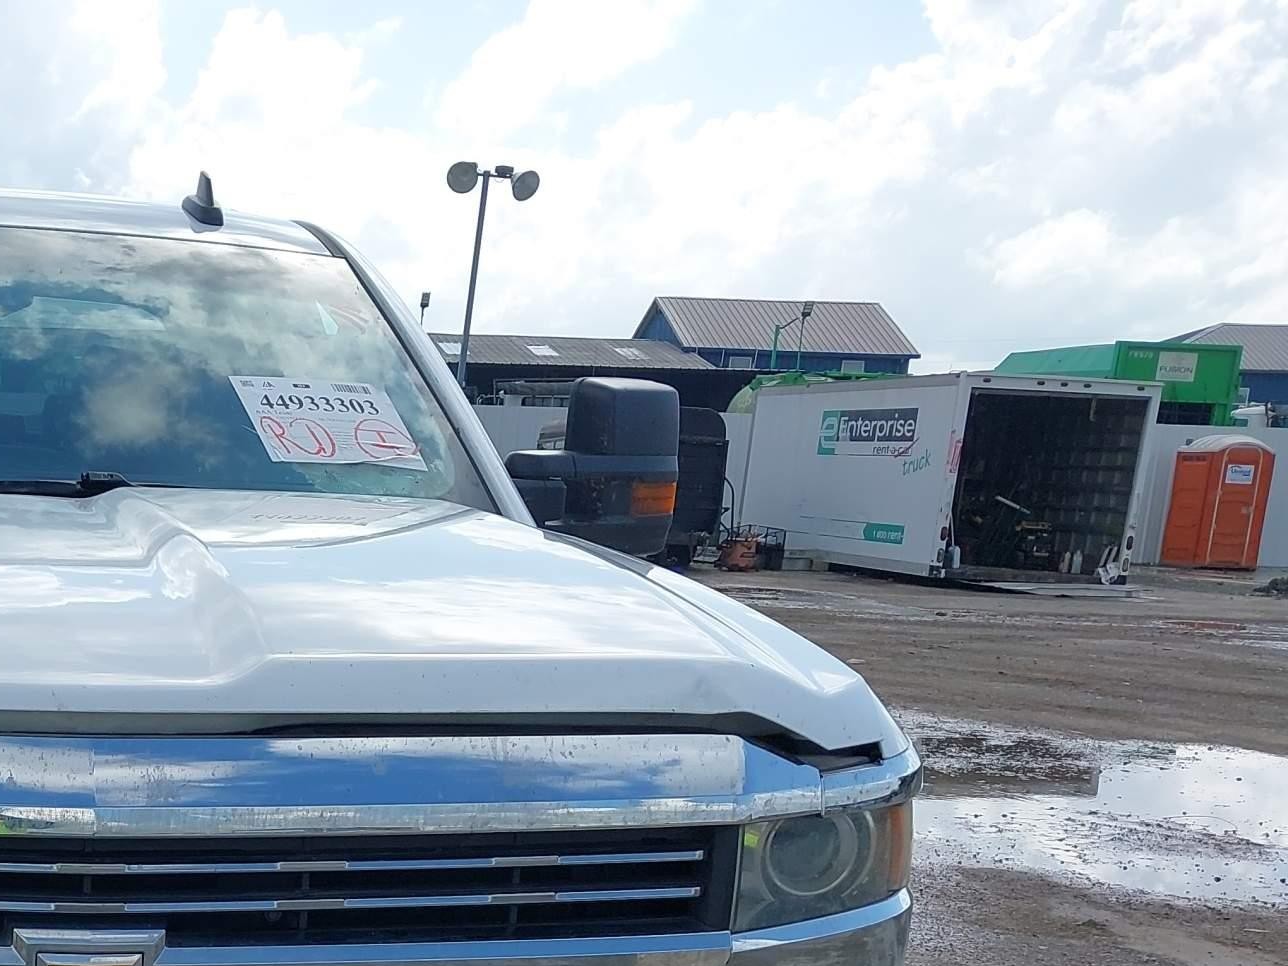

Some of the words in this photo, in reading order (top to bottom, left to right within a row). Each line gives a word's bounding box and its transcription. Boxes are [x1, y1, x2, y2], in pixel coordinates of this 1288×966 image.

[259, 394, 380, 415] 44933303
[838, 413, 916, 442] Enterprise
[902, 447, 932, 476] truck
